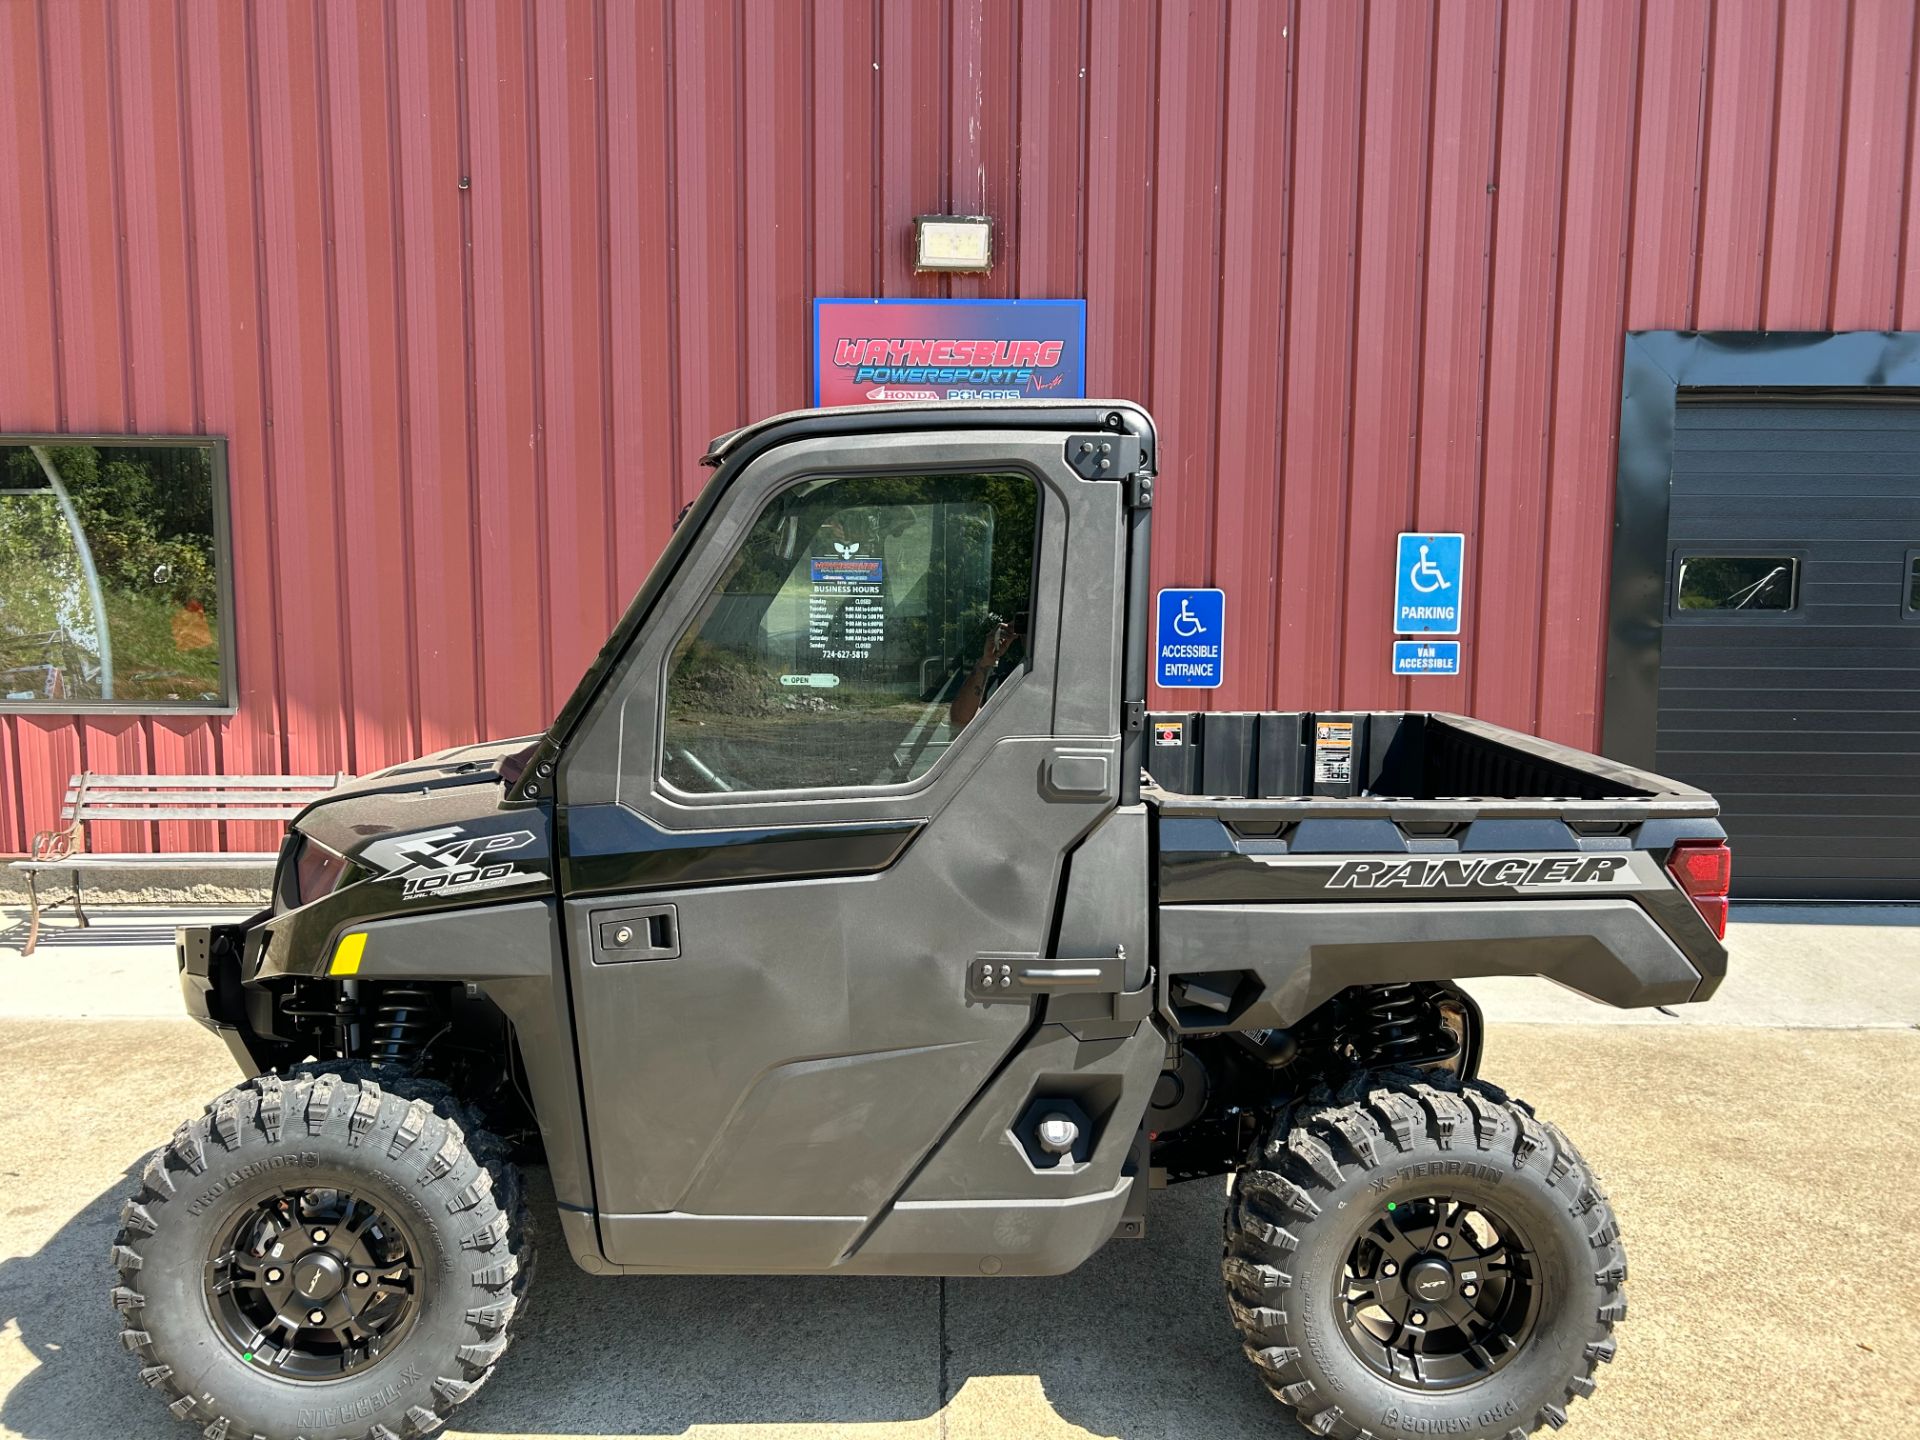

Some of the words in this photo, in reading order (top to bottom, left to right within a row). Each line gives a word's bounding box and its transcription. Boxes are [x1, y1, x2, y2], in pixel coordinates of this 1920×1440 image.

[833, 338, 1065, 367] WAYNESBURG
[854, 367, 1032, 384] POWERSPORTS
[883, 390, 938, 400] HONDA
[947, 390, 1020, 399] POLARIS
[1401, 606, 1454, 620] PARKING
[822, 650, 869, 659] 724-627-5819
[1162, 645, 1218, 658] ACCESSIBLE
[1417, 648, 1435, 657] VAN
[1165, 664, 1213, 676] ENTRANCE
[1399, 658, 1453, 669] ACCESSIBLE
[372, 830, 536, 882] XP
[402, 863, 515, 895] 1000
[1325, 855, 1629, 888] RANGER
[402, 892, 428, 900] DUAL
[429, 882, 484, 896] OVERHEAD
[484, 879, 507, 888] CAM
[187, 1182, 226, 1216] PRO
[225, 1154, 299, 1190] ARMOR
[1369, 1160, 1505, 1196] X-TERRAIN
[297, 1362, 424, 1429] X-TERRAIN
[1478, 1398, 1519, 1427] PRO
[1401, 1415, 1473, 1435] ARMOR
